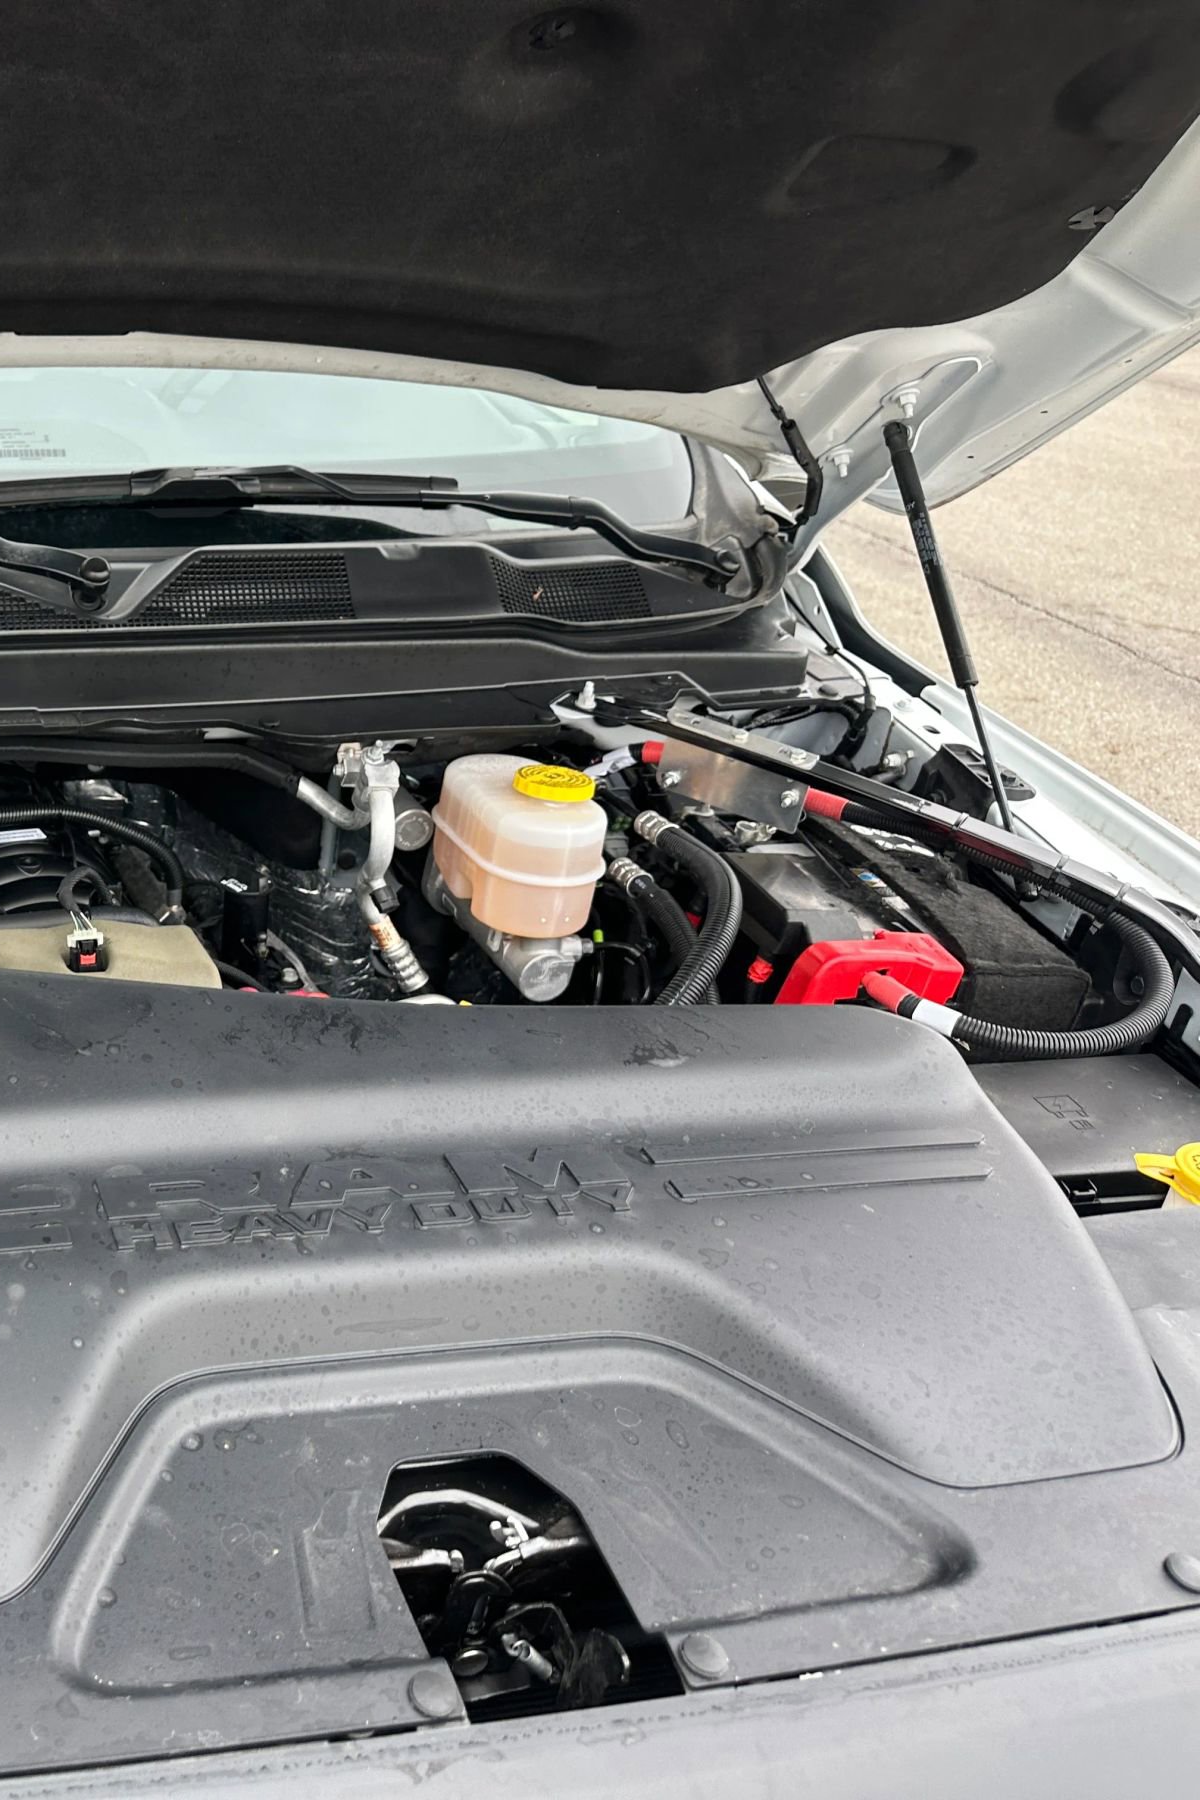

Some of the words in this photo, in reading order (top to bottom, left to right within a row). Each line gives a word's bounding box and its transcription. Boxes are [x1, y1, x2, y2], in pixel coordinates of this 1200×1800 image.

[92, 1146, 631, 1222] RAM
[110, 1201, 394, 1252] HEAVY
[409, 1184, 634, 1228] DUTY
